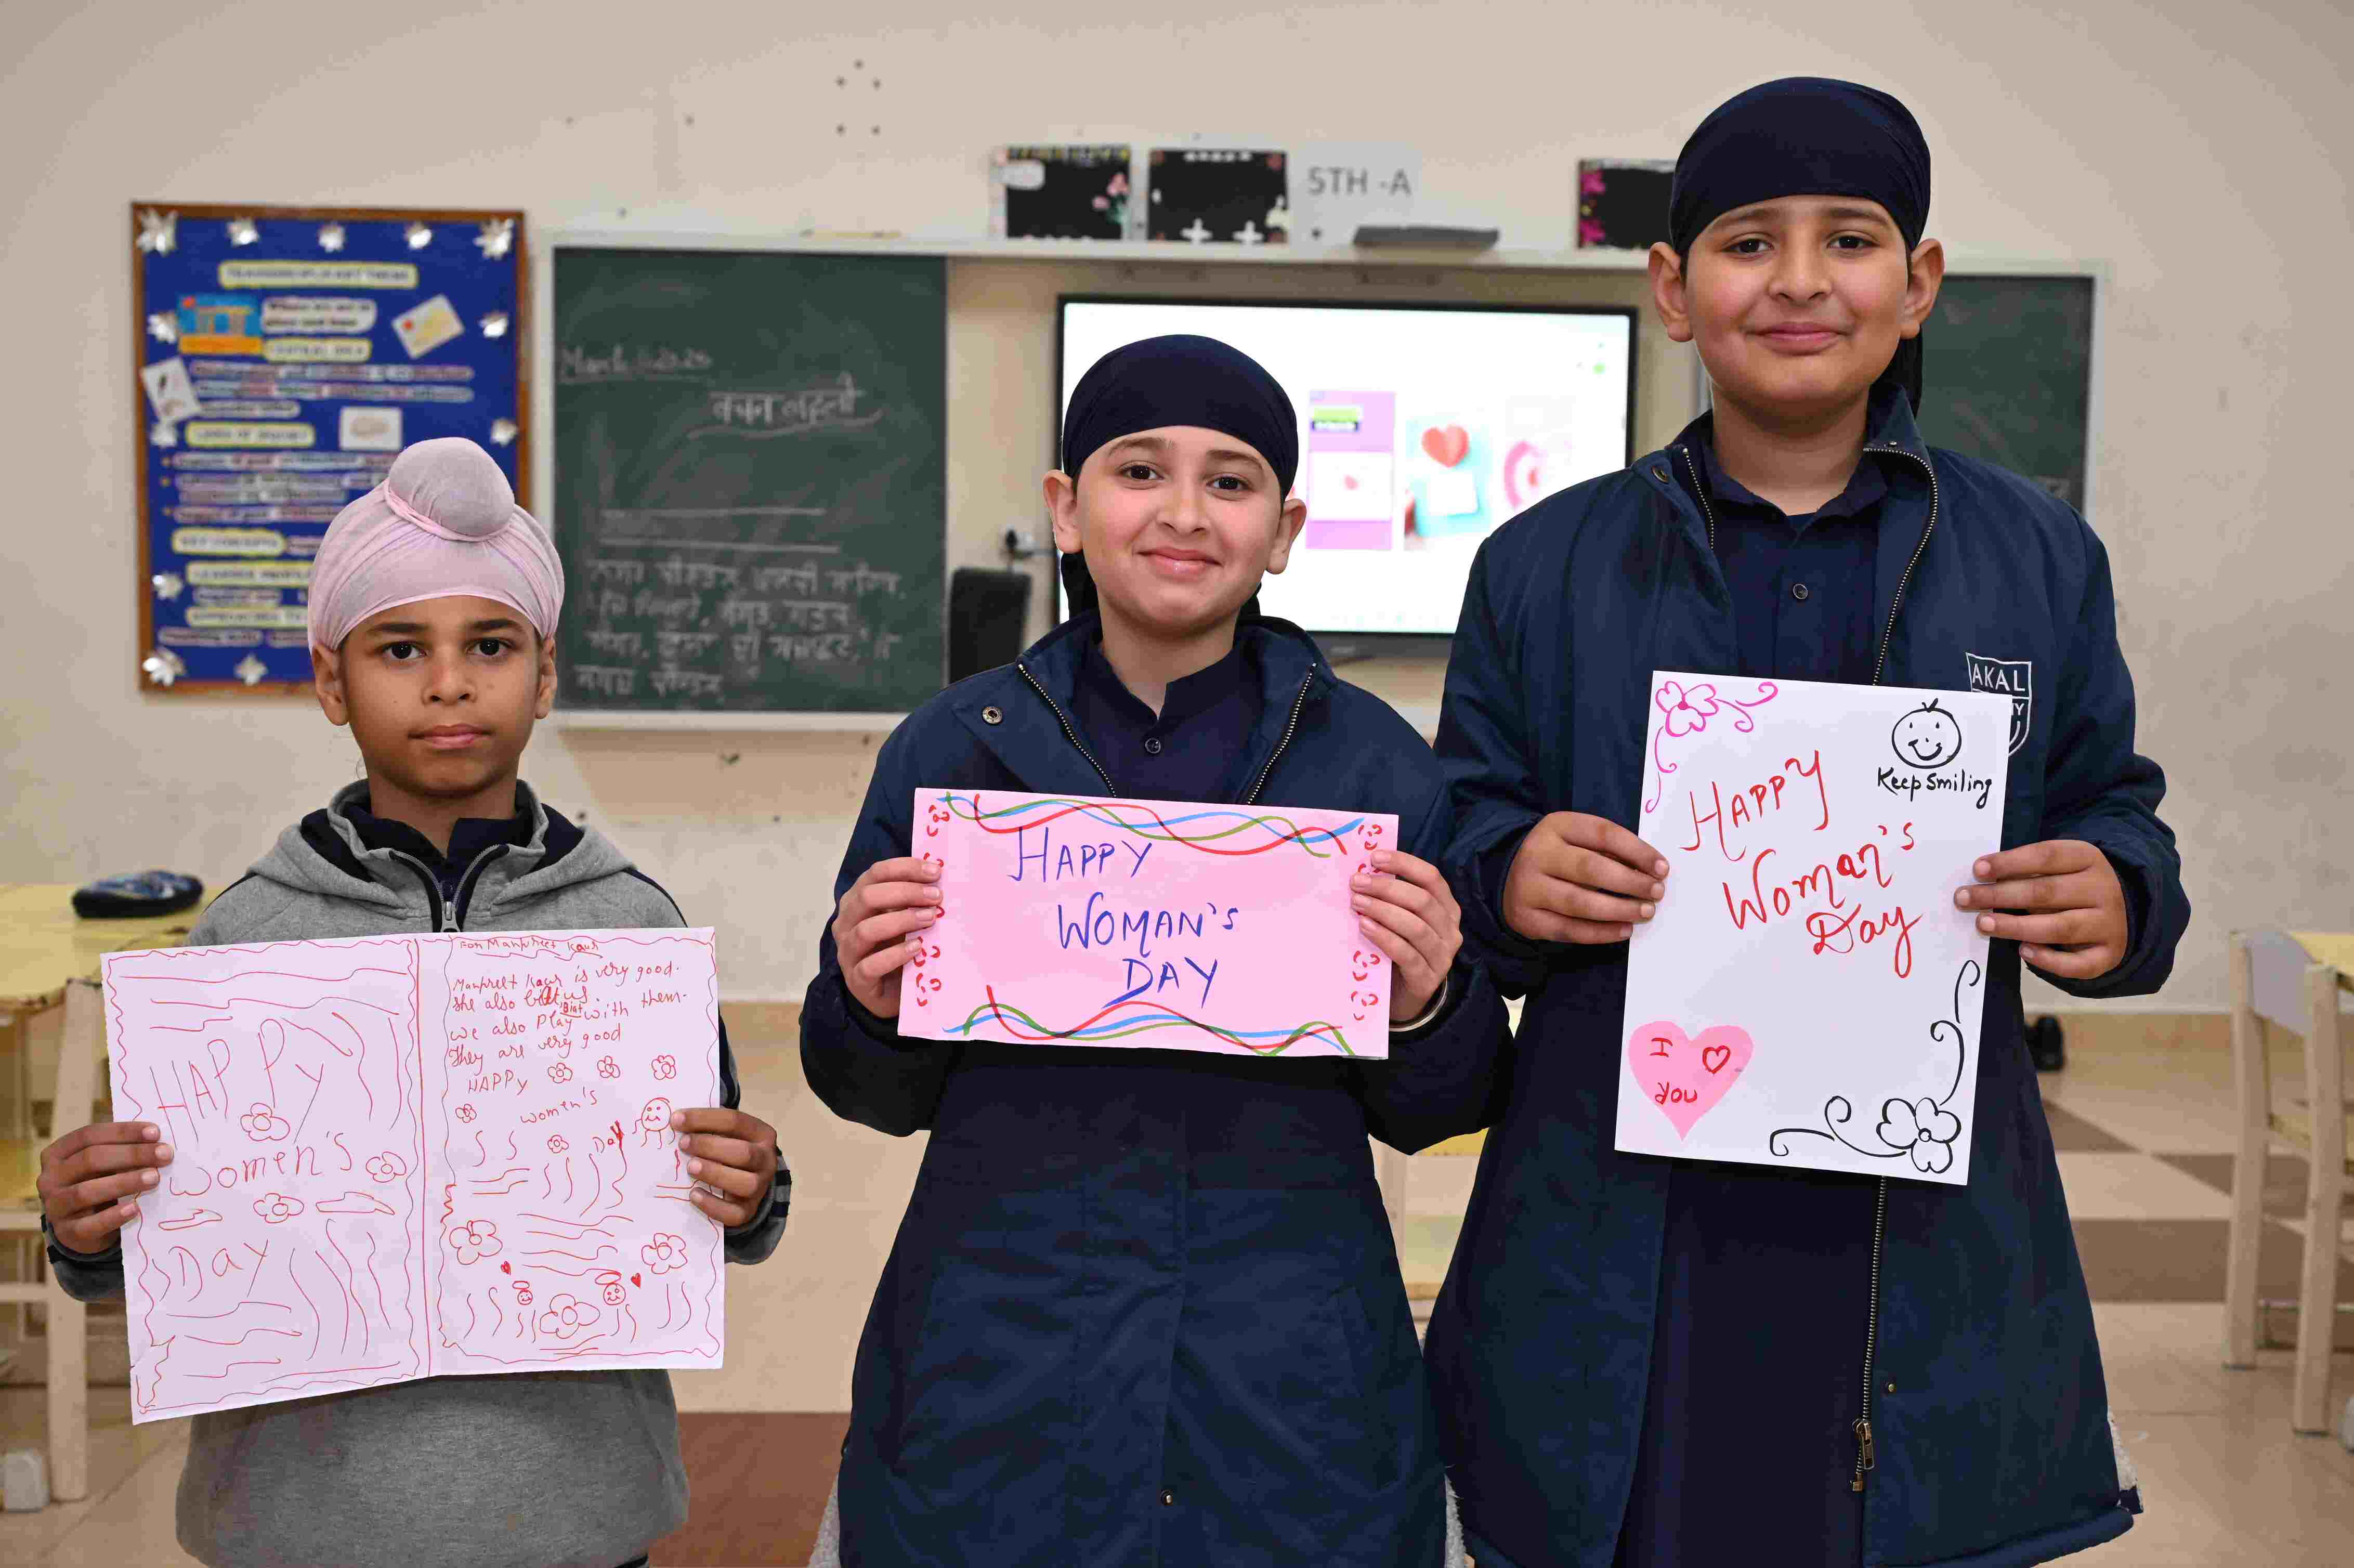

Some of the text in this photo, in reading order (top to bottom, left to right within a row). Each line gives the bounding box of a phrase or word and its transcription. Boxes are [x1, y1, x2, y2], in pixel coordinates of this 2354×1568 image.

[1306, 166, 1368, 196] 5TH
[1972, 663, 2025, 691] AKAL
[1878, 767, 1921, 802] Keep
[1679, 750, 1828, 861] HAPPY
[1007, 827, 1153, 883] HAPPY
[1058, 892, 1238, 957] WOMAN'S
[1806, 903, 1924, 978] Day
[575, 965, 588, 983] is
[596, 962, 628, 987] very
[1102, 957, 1218, 1009] DAY
[486, 991, 515, 1011] also
[492, 1015, 526, 1035] also
[584, 1001, 629, 1020] with
[499, 1045, 525, 1059] are
[538, 1035, 572, 1059] very
[582, 1023, 621, 1049] good
[1650, 1038, 1673, 1057] I
